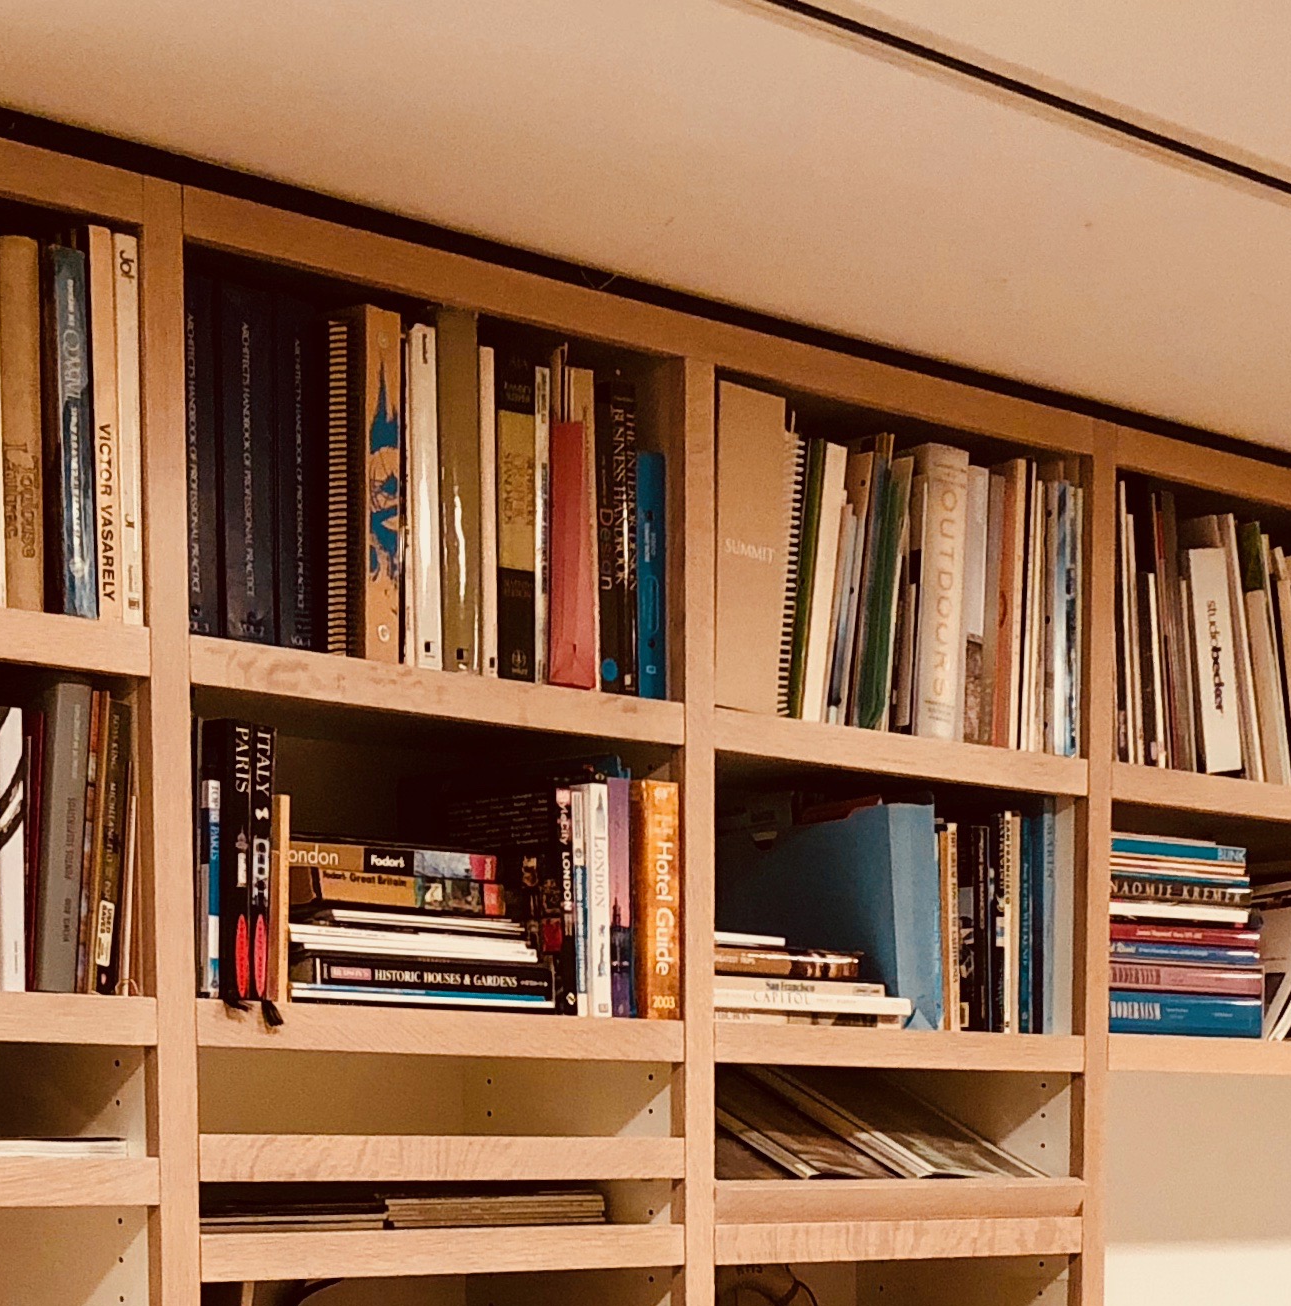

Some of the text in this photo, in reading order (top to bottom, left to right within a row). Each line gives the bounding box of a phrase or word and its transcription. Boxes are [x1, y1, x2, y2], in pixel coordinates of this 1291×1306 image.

[187, 380, 198, 442] HANDBOOK
[242, 388, 253, 451] HANDBOOK
[294, 403, 303, 466] HANDBOOK
[610, 405, 626, 484] BUSINESS
[189, 446, 199, 461] OF
[20, 457, 41, 559] Toulouse
[98, 422, 116, 602] VICTOR VASARELY
[189, 464, 201, 540] PROFESSIONAL
[243, 469, 255, 545] PROFESSIONAL
[295, 484, 304, 560] PROFESSIONAL
[191, 543, 202, 593] PRACTICE
[245, 547, 255, 597] PRACTICE
[599, 507, 614, 591] Design
[296, 561, 305, 611] PRACTICE
[933, 489, 957, 698] OUTDOORS
[1205, 599, 1226, 714] studiobecker
[234, 724, 250, 794] PARIS
[254, 730, 271, 797] ITALY
[289, 847, 339, 866] ondon
[349, 872, 376, 885] Great
[376, 874, 408, 888] Britain
[562, 851, 573, 911] LONDON
[594, 835, 607, 908] LONDON
[1110, 879, 1172, 900] NAOMIE
[654, 840, 675, 976] Hotel Guide
[374, 968, 422, 985] HISTORIC
[422, 970, 461, 986] HOUSES
[472, 974, 519, 988] GARDENS
